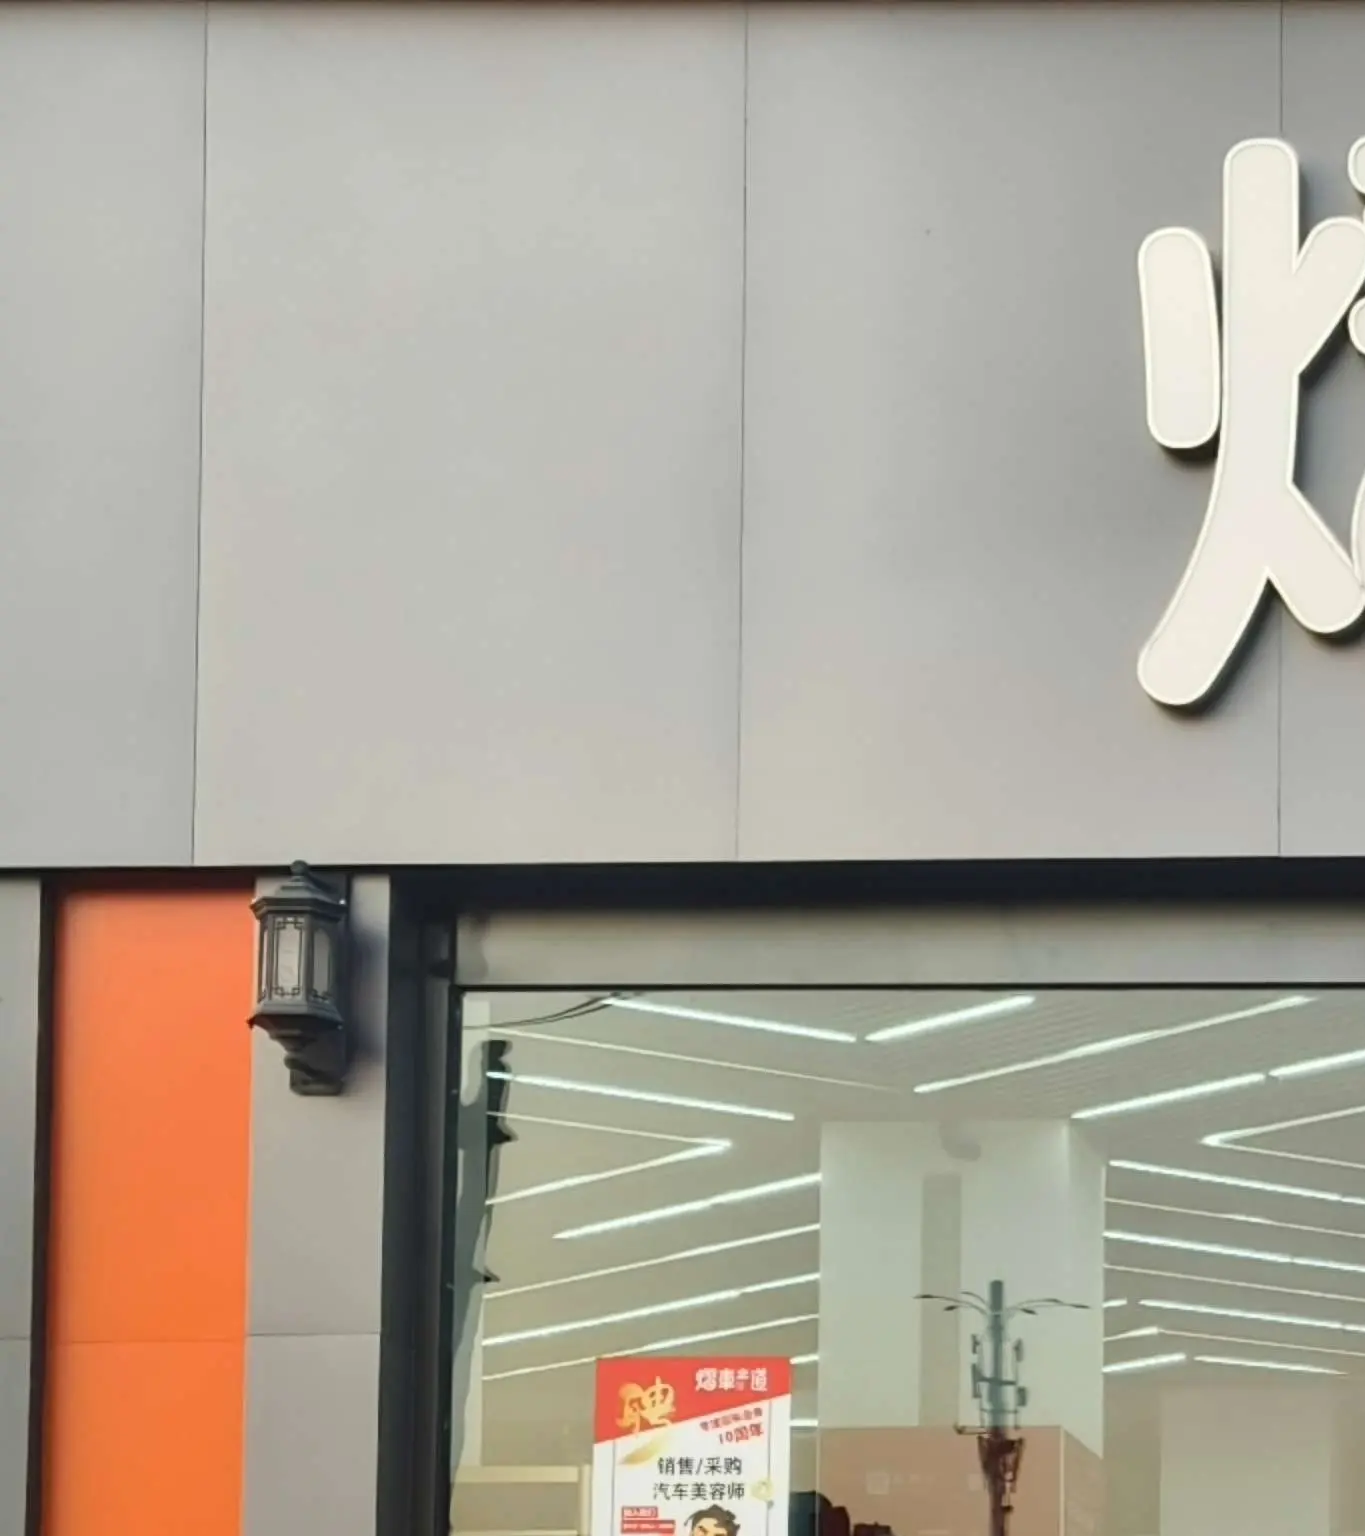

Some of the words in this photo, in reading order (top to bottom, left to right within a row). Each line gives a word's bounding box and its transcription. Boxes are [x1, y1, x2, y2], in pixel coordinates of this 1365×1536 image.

[657, 1456, 743, 1476] 销售/采购
[652, 1482, 745, 1501] 汽车美容师
